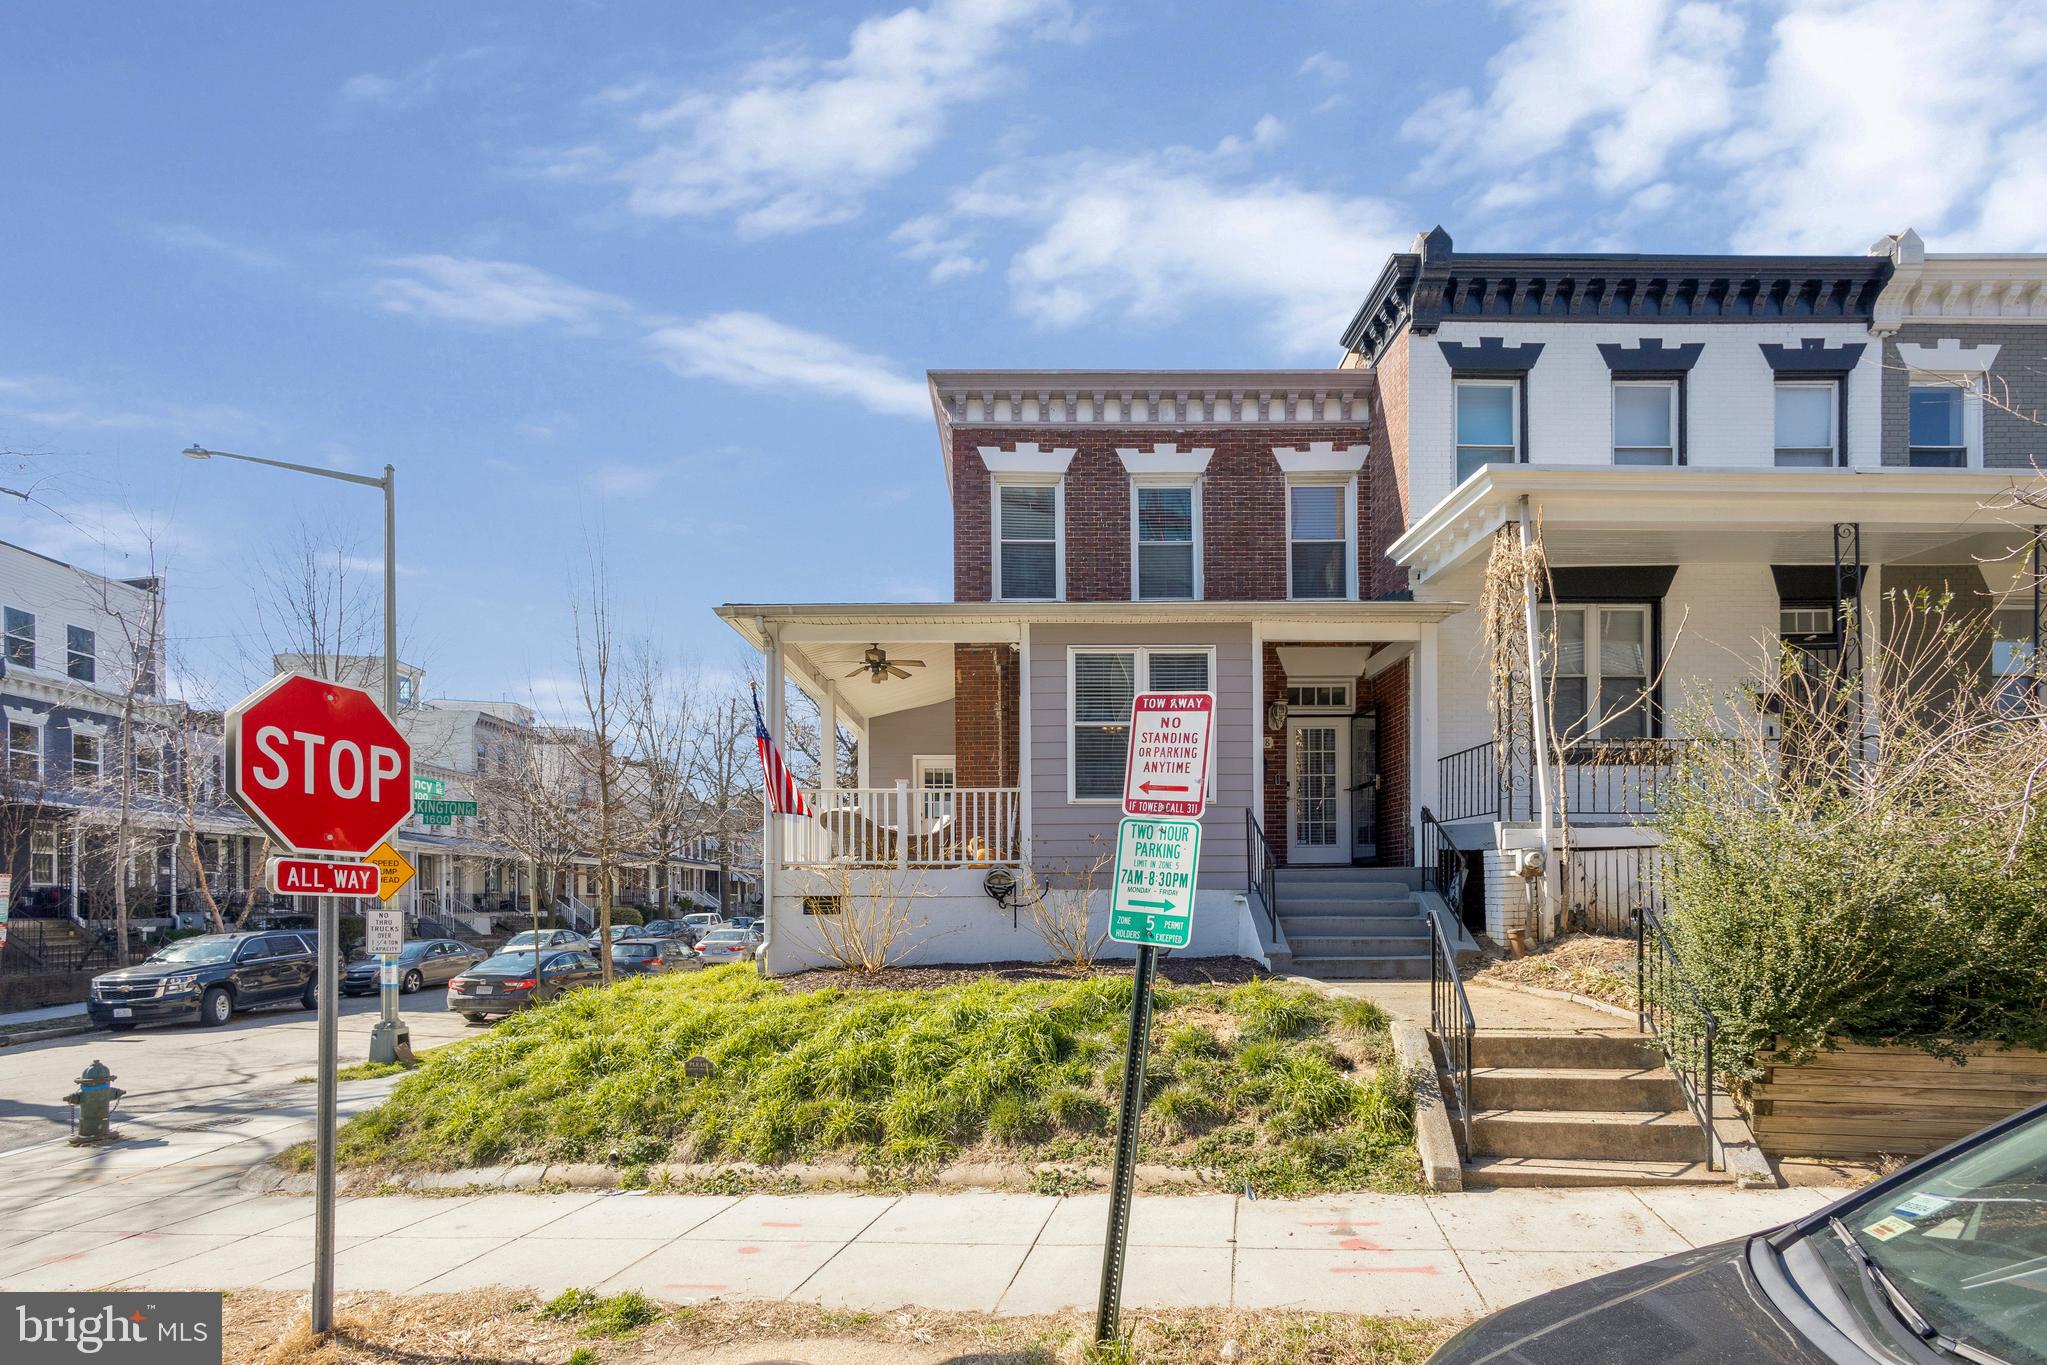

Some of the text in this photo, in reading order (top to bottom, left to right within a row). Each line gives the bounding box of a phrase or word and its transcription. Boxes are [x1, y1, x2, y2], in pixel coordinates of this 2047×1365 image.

[1144, 698, 1204, 708] TOW AWAY
[1160, 717, 1181, 728] NO
[1141, 732, 1198, 744] STANDING
[1139, 747, 1198, 758] OR PARKING
[252, 725, 402, 802] STOP
[1144, 762, 1191, 774] ANYTIME
[414, 780, 432, 793] ncy
[1129, 802, 1198, 814] IF TOWED CALL 311
[424, 815, 449, 824] 1600
[1132, 824, 1189, 842] TWO HOUR
[1135, 842, 1181, 859] PARKING
[1159, 861, 1172, 869] ZONE
[287, 867, 370, 889] ALL WAY
[1121, 869, 1188, 888] 7AM-8:30PM
[1116, 915, 1184, 931] ZONE 5 PERMIT
[1116, 930, 1182, 944] HOLDERS EXCEPTED
